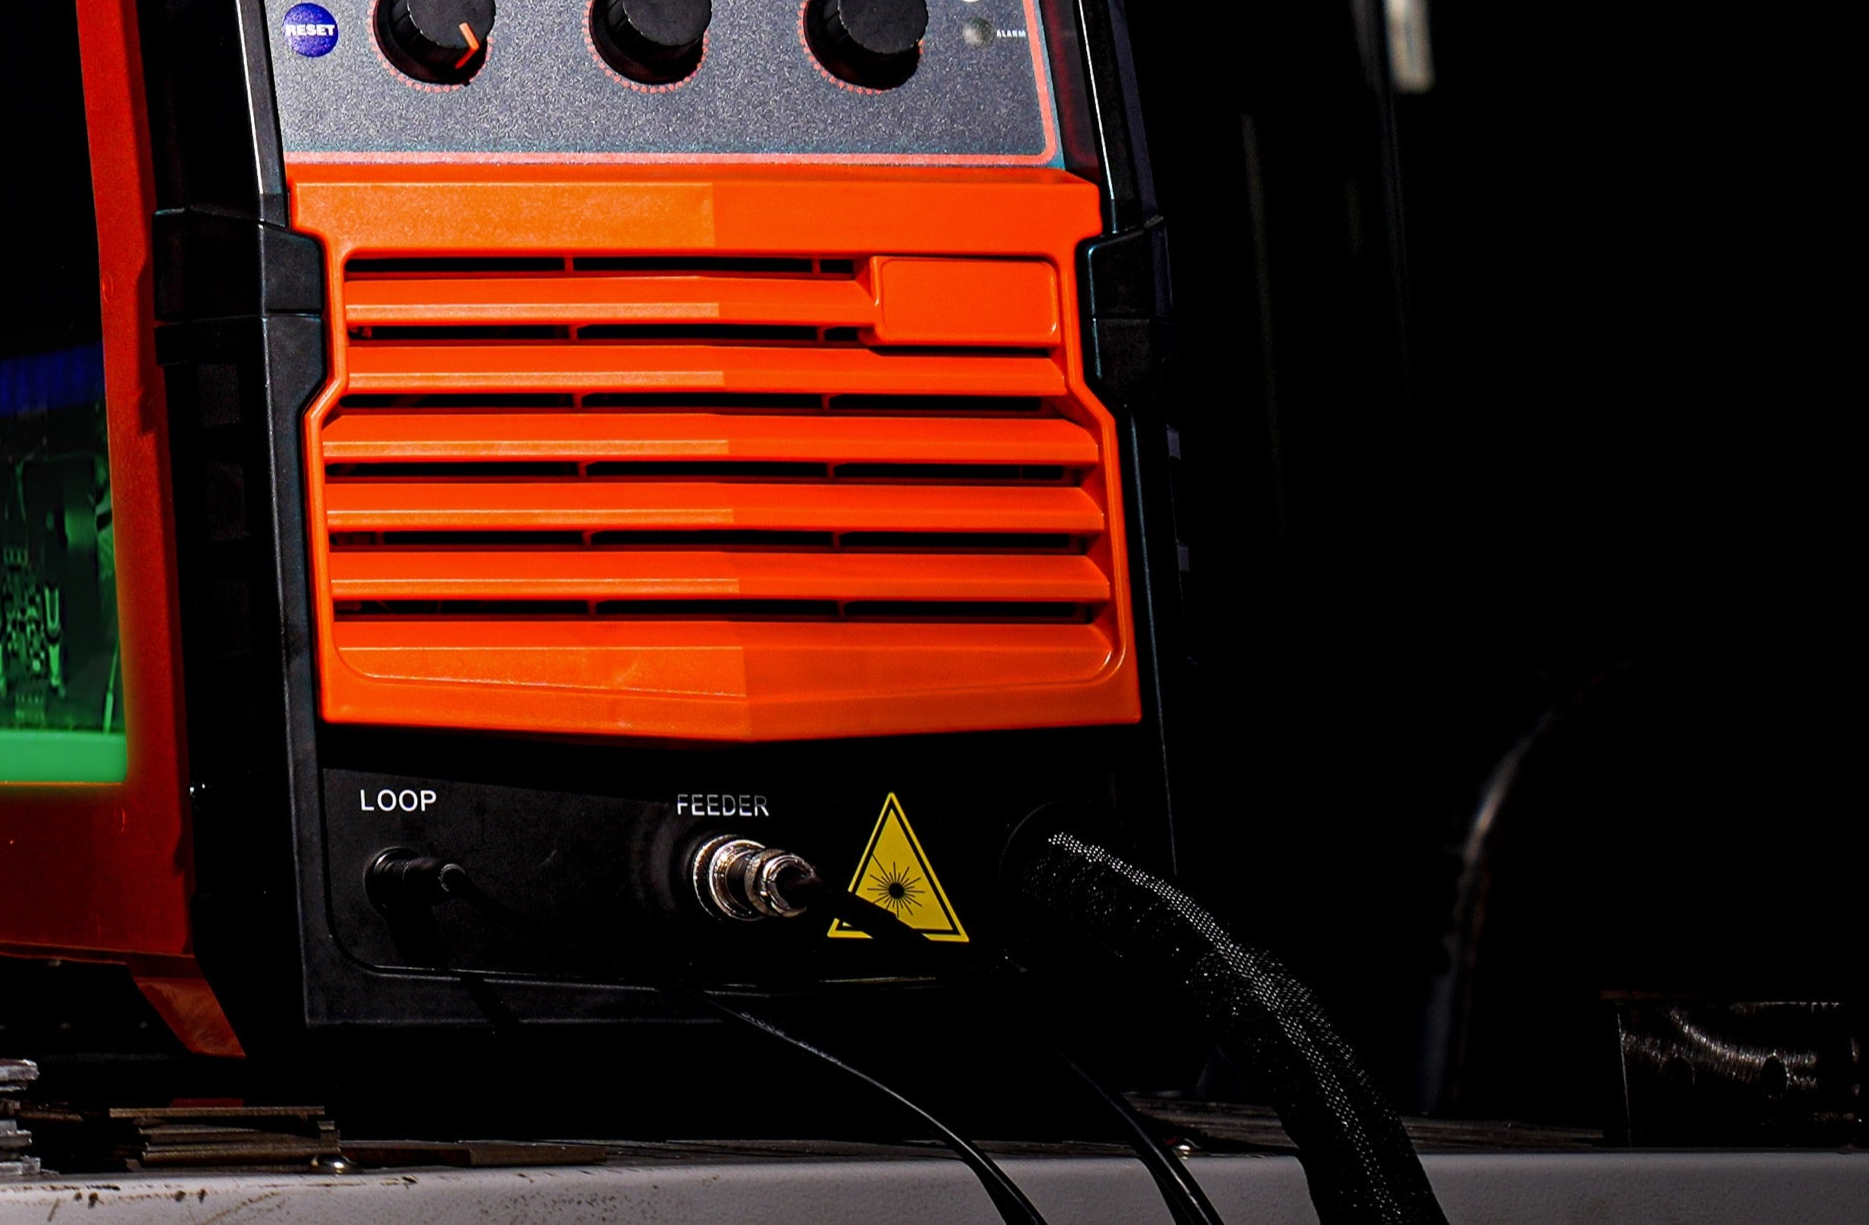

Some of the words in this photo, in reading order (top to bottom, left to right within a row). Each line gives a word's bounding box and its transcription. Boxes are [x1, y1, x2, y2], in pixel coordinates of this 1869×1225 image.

[285, 23, 336, 36] RESET
[360, 788, 437, 813] LOOP
[676, 794, 770, 818] FEEDER
